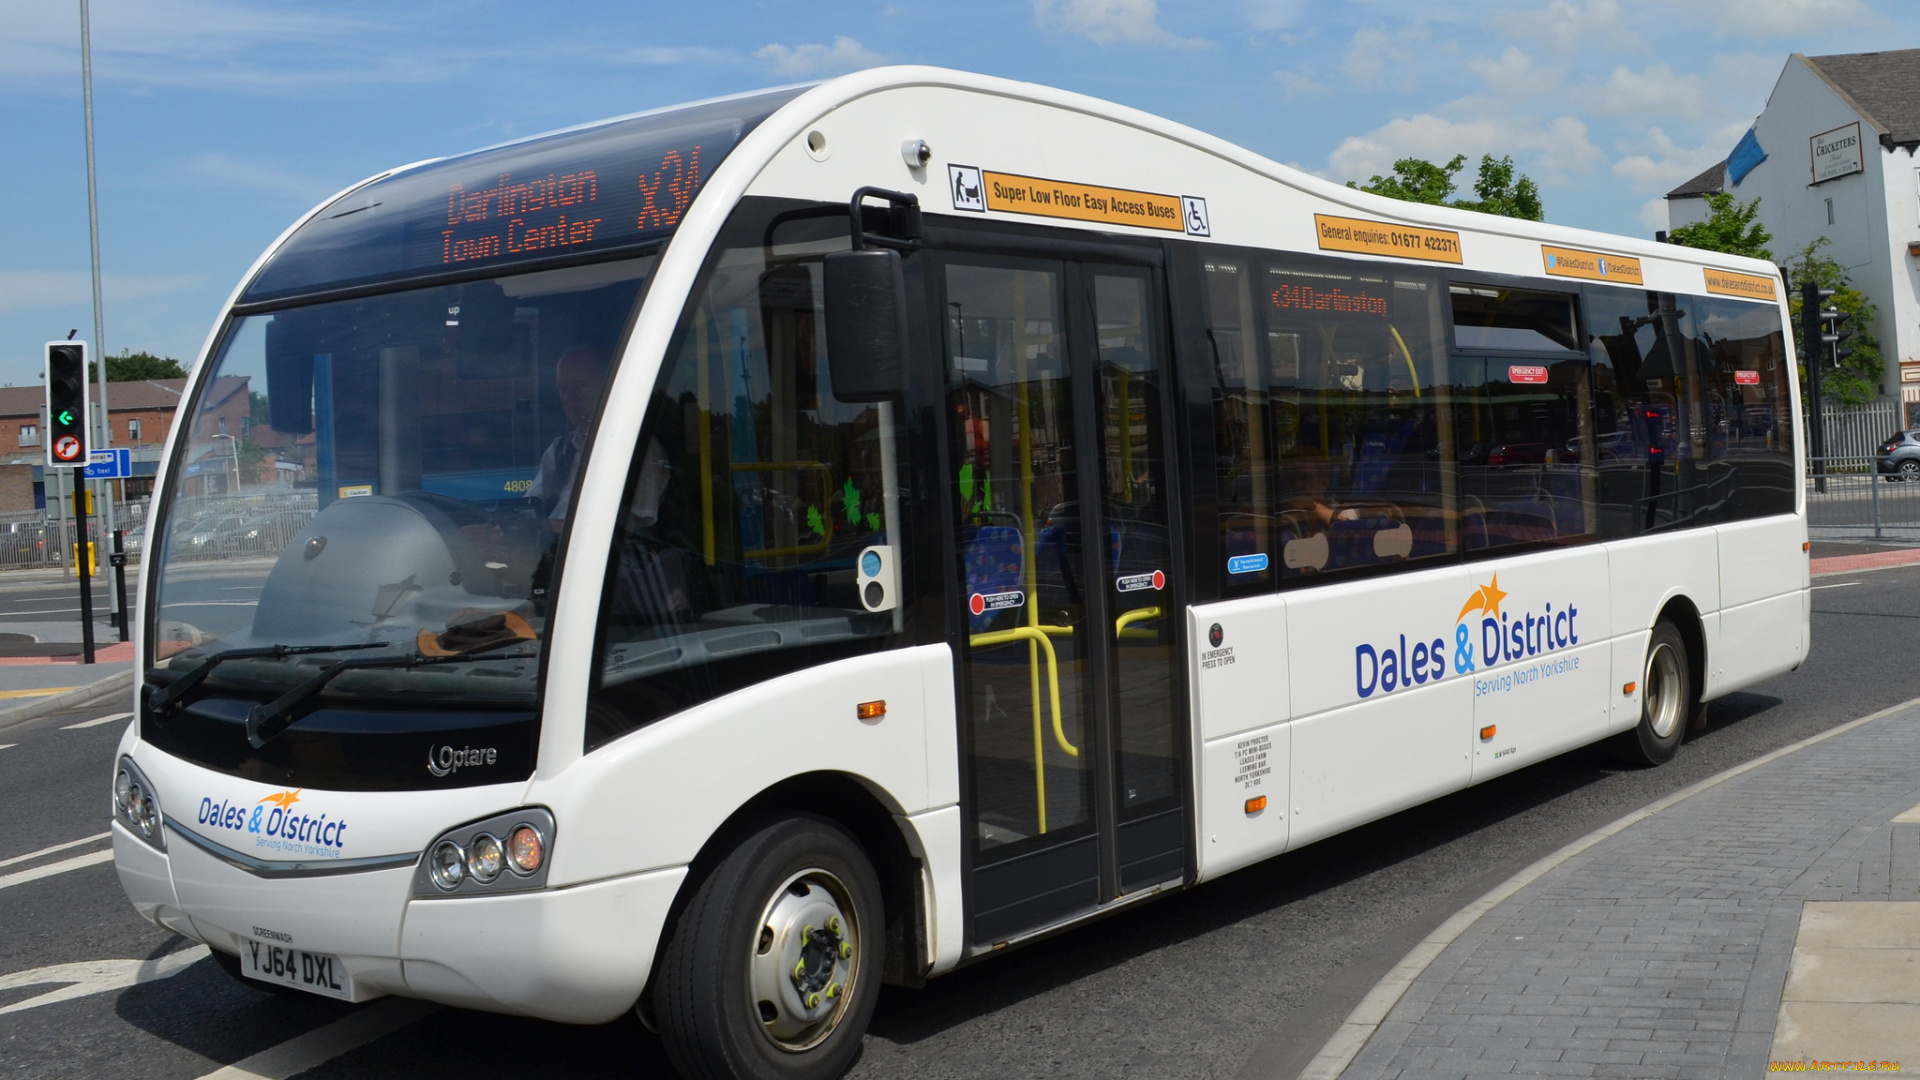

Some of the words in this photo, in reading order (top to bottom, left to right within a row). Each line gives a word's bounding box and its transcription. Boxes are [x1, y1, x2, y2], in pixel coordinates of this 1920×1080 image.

[1816, 136, 1856, 157] CRICKETERS
[448, 170, 597, 226] Darlington
[993, 181, 1027, 204] Super
[1029, 186, 1051, 204] Low
[1053, 189, 1081, 208] Floor
[1083, 193, 1107, 214] Easy
[1111, 196, 1145, 216] Access
[1147, 201, 1176, 219] Buses
[441, 229, 500, 263] Town
[507, 215, 602, 253] Center
[1321, 222, 1353, 241] General
[1353, 228, 1390, 246] enquiries:
[1391, 231, 1421, 248] 01677
[1424, 236, 1458, 253] 422371
[448, 305, 460, 315] up
[1201, 652, 1207, 661] IN
[1207, 646, 1234, 660] EMERGENCY
[1202, 659, 1217, 670] PRESS
[1217, 657, 1223, 667] TO
[1223, 655, 1236, 665] OPEN
[1355, 633, 1446, 699] Dales
[1454, 623, 1475, 675] &
[1481, 602, 1578, 667] District
[1475, 675, 1512, 697] Serving
[1513, 666, 1539, 686] North
[1540, 655, 1580, 679] Yorkshire
[437, 745, 497, 774] Optare
[1240, 755, 1255, 766] LEASES
[1255, 752, 1267, 761] FARM
[1240, 762, 1258, 774] LEEMING
[1258, 760, 1267, 769] BAR
[1234, 773, 1249, 783] NORTH
[1249, 766, 1272, 779] YORKSHIRE
[198, 796, 246, 831] Dales
[248, 804, 264, 834] &
[266, 807, 348, 848] District
[256, 836, 281, 852] Serving
[282, 839, 303, 853] North
[304, 843, 341, 859] Yorkshire
[252, 925, 294, 944] SCREENWASH
[249, 940, 297, 980] YJ64
[301, 952, 342, 991] DXL
